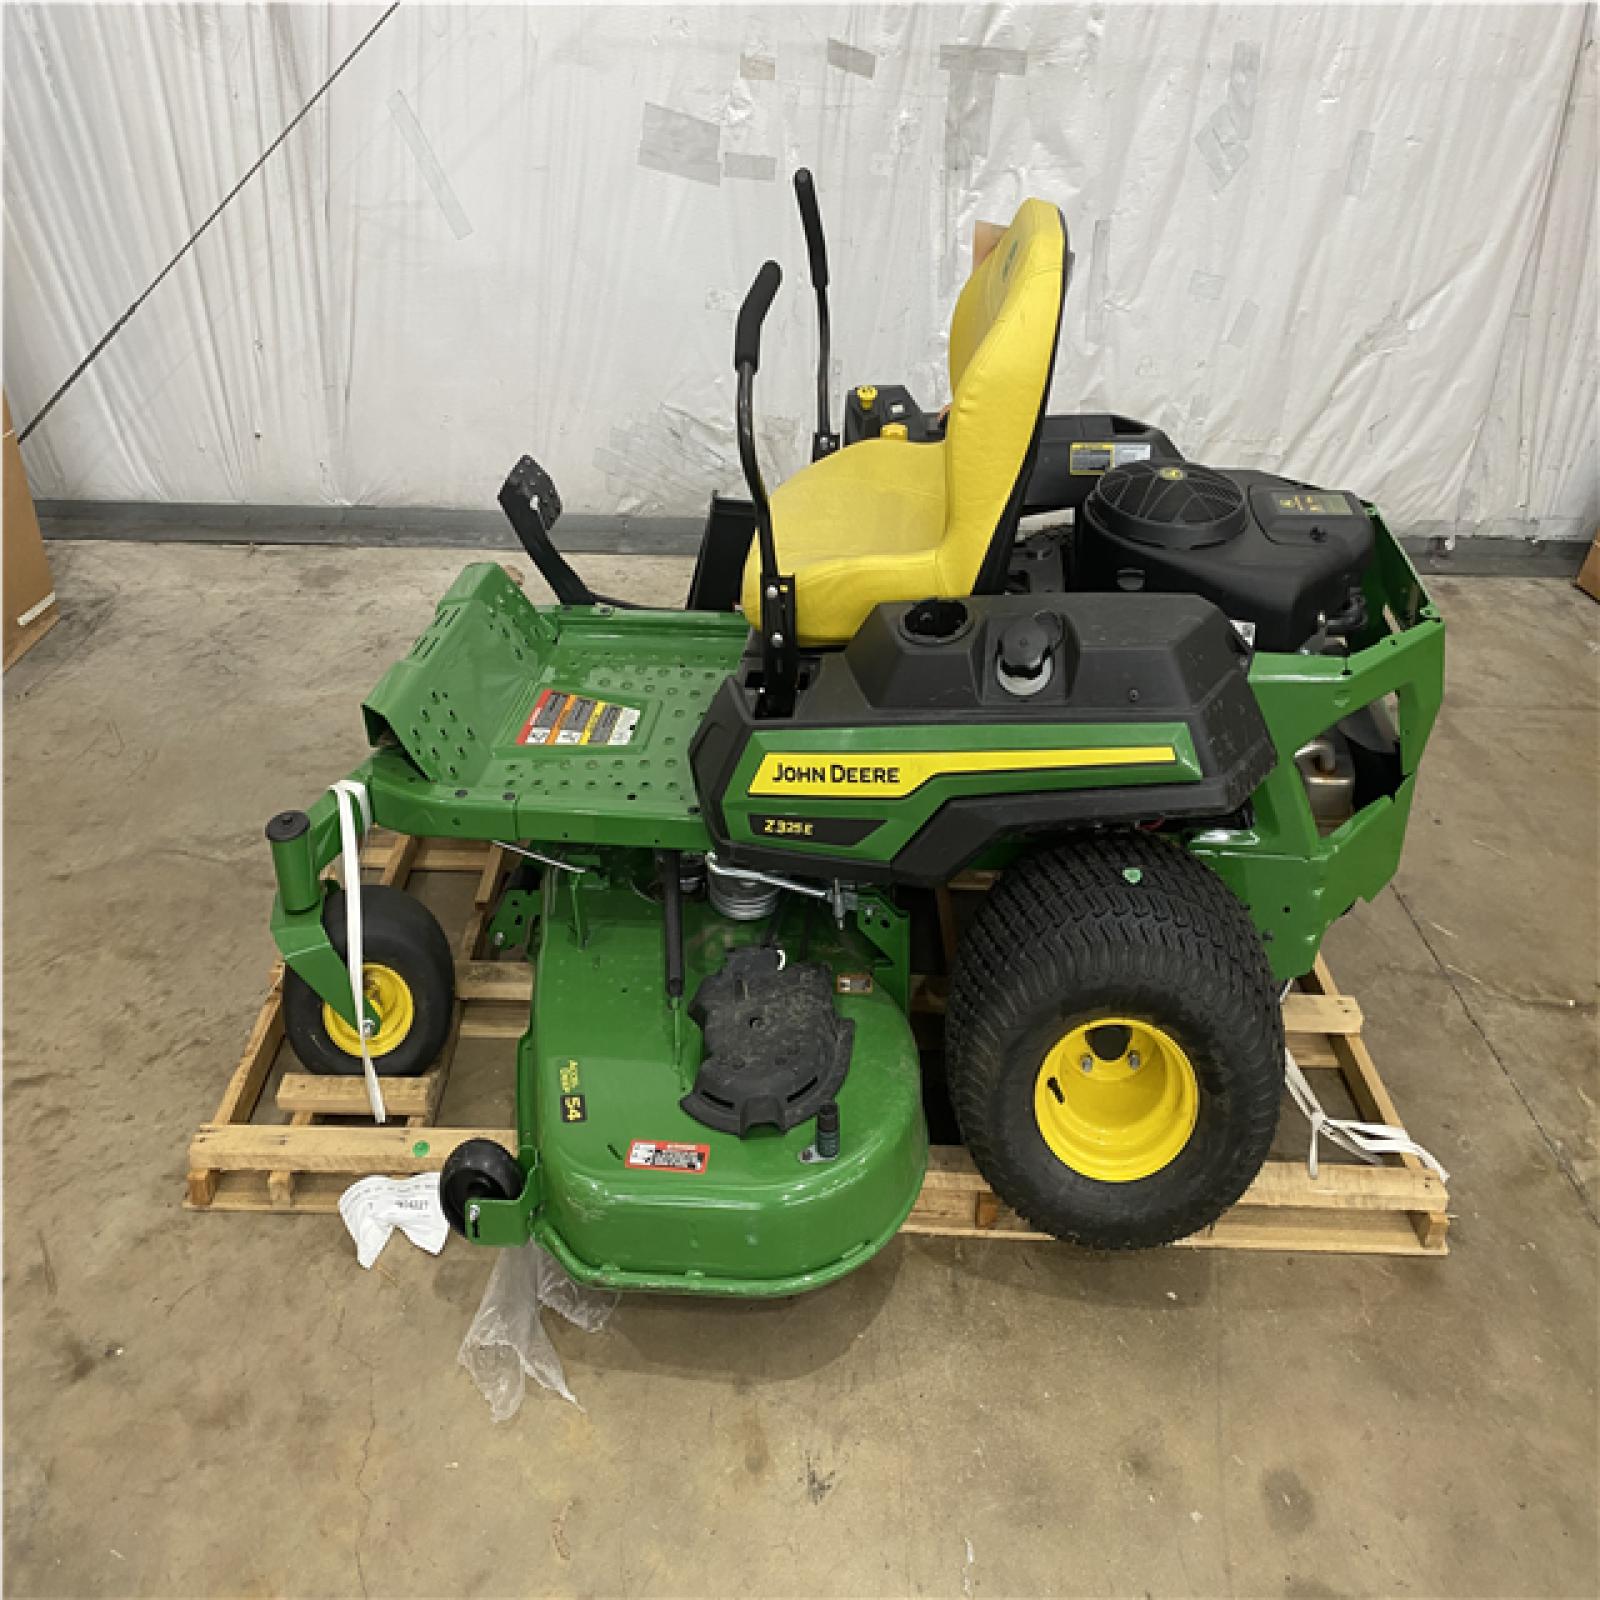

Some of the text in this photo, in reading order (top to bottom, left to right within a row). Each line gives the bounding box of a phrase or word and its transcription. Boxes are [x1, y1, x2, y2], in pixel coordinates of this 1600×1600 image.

[772, 762, 901, 783] JOHN DEERE
[564, 1096, 581, 1121] 54
